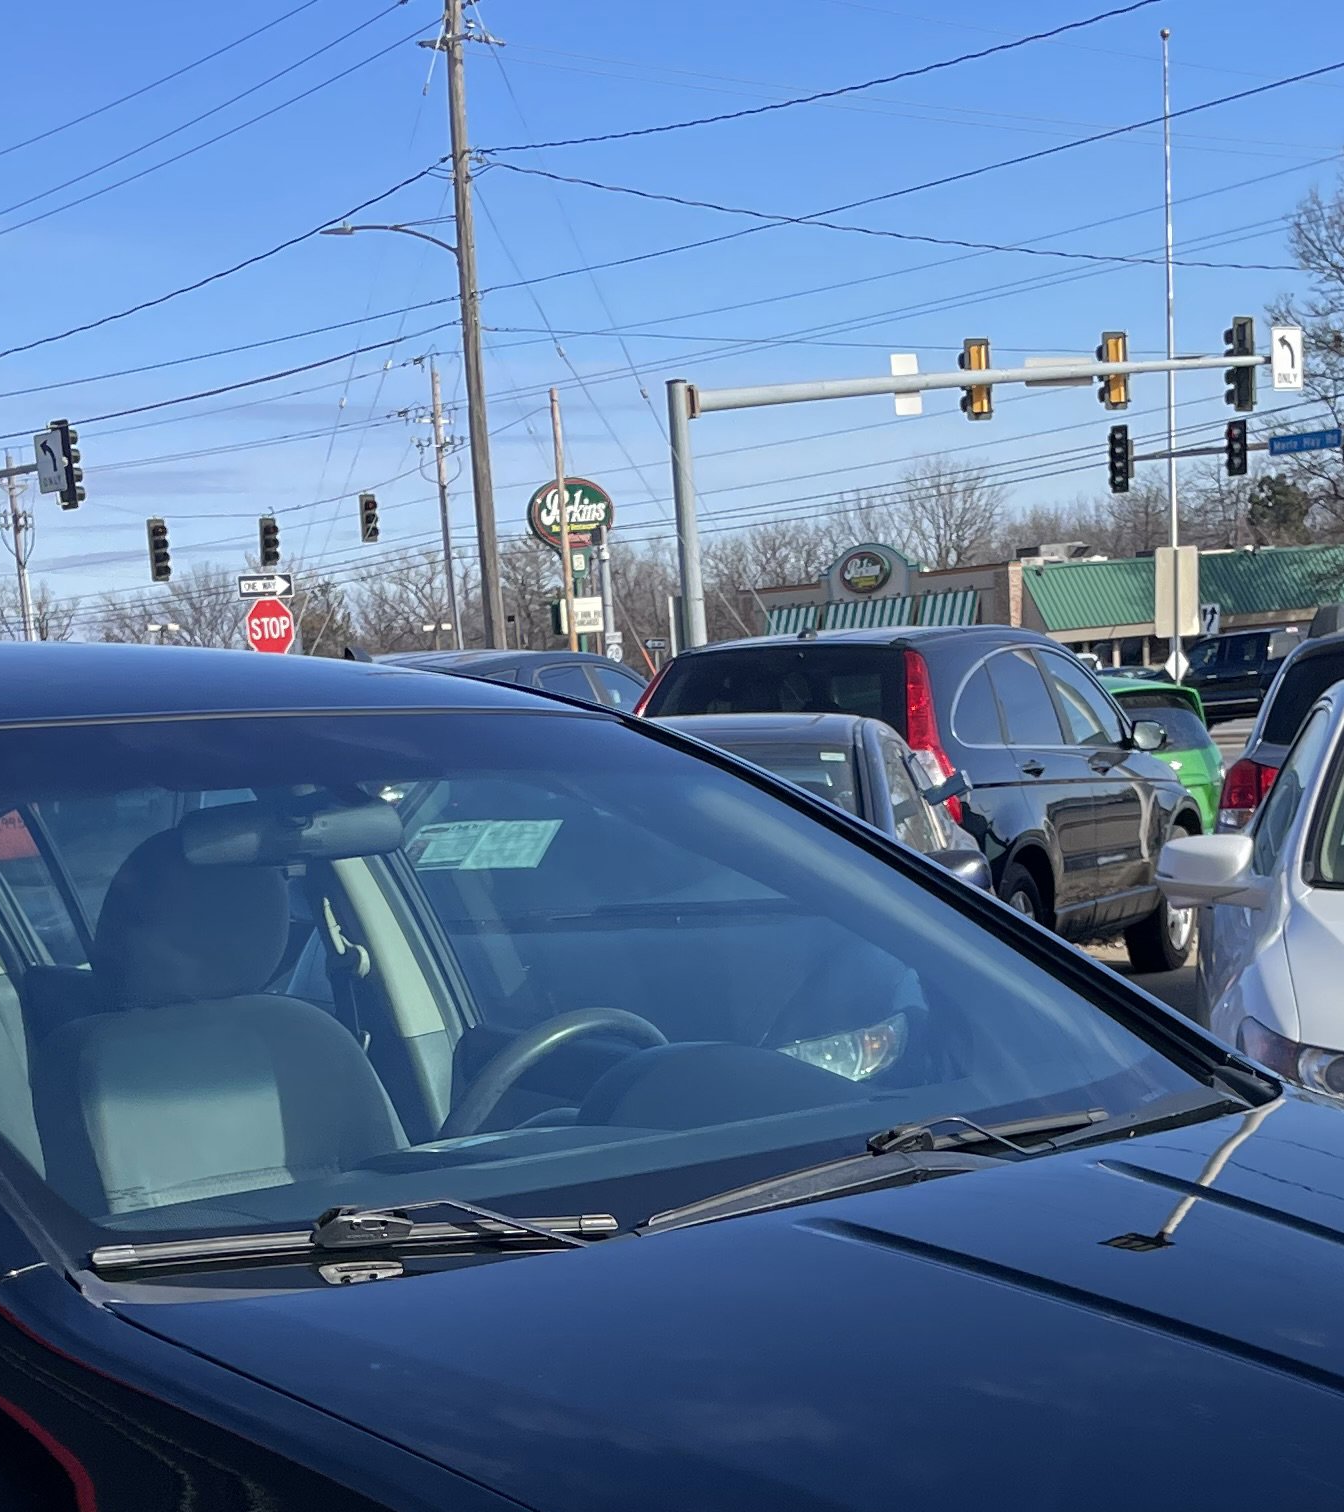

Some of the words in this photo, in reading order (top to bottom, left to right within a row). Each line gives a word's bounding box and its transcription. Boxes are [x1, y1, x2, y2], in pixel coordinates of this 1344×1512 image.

[1277, 372, 1298, 385] ONLY
[244, 582, 258, 592] ONE
[262, 581, 276, 590] WAY
[250, 616, 290, 641] STOP
